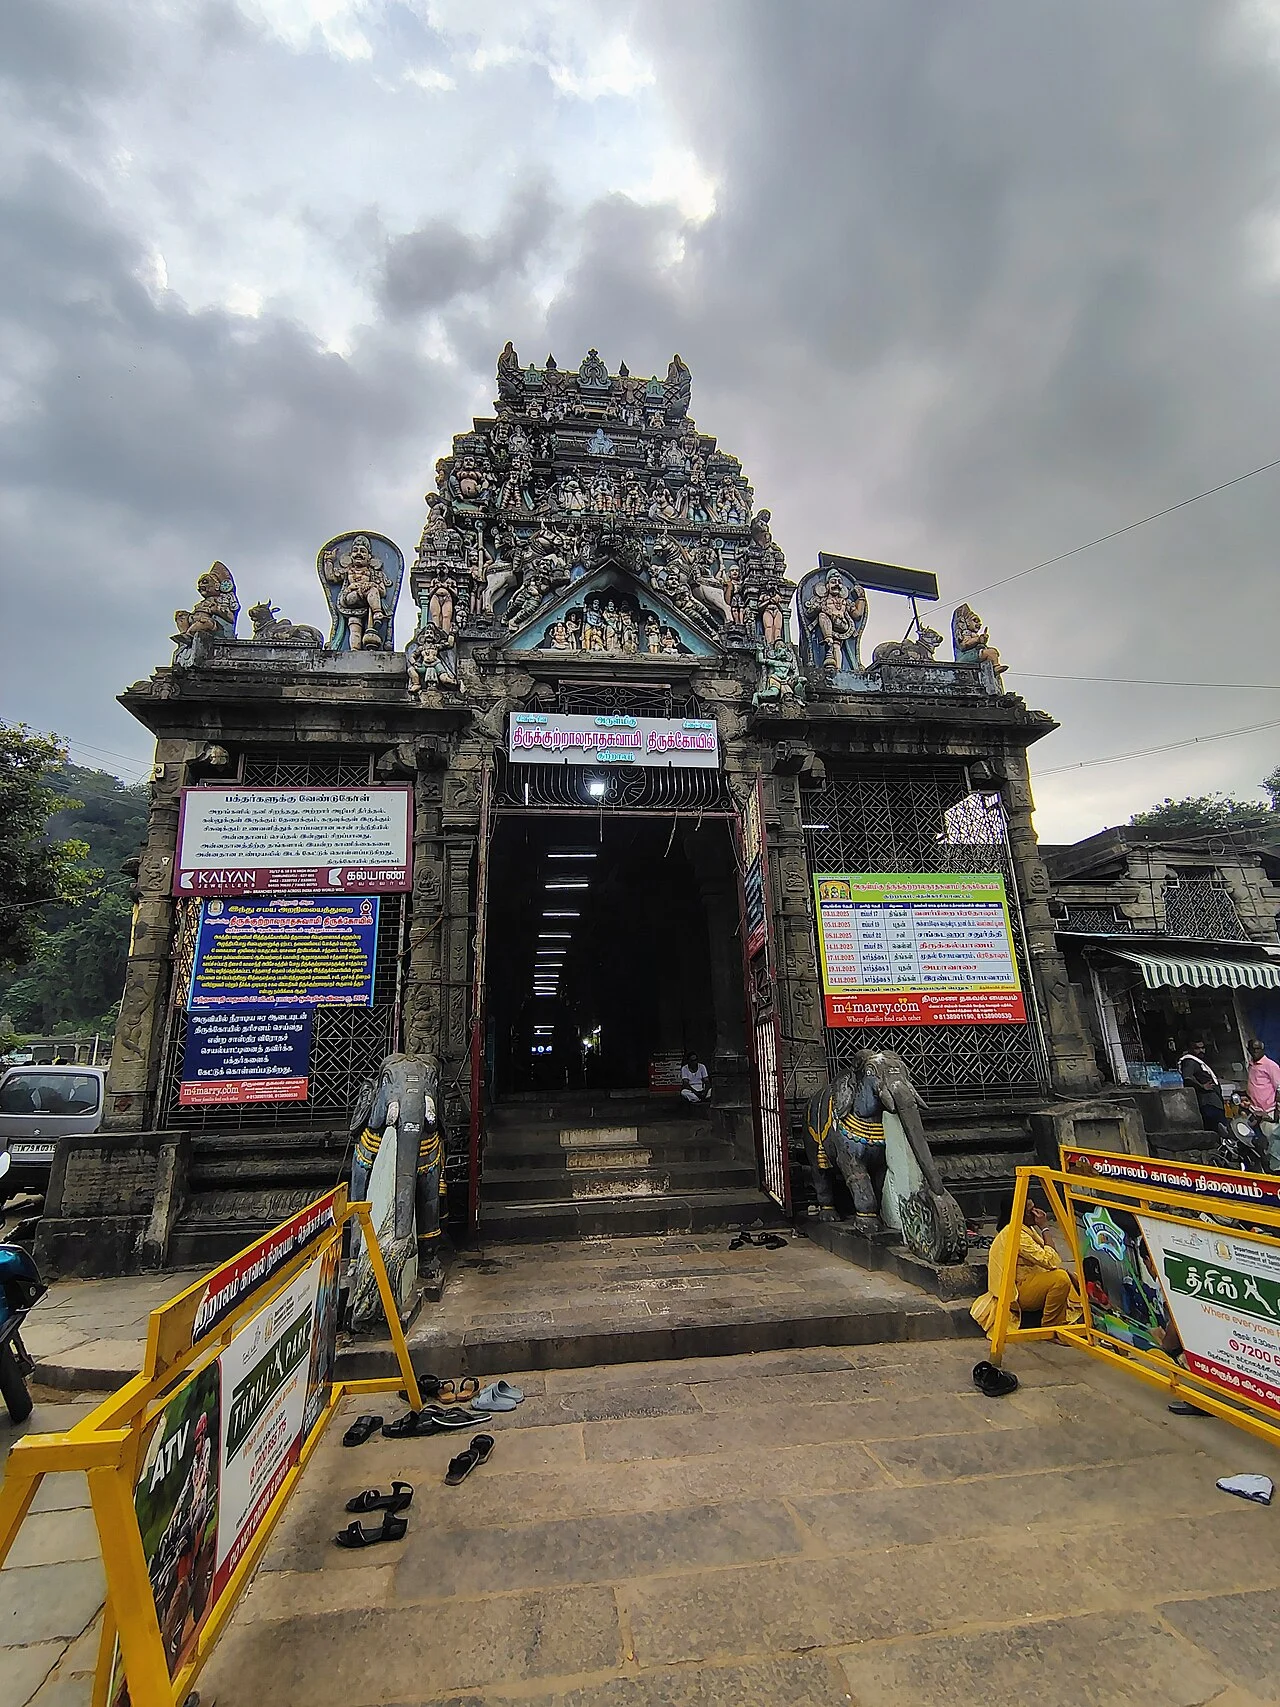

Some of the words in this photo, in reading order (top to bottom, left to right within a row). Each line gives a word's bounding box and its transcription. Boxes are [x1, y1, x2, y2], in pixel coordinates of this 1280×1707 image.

[594, 714, 637, 727] அருள்மிகு
[513, 726, 643, 751] திருக்குற்றாலநாதசுவாமி
[646, 729, 717, 753] திருக்கோயில்
[596, 750, 635, 762] குற்றாலம்
[225, 794, 296, 804] பக்தர்களுக்கு
[299, 793, 371, 803] வேண்டுகோள்
[198, 870, 256, 883] KALYAN
[346, 867, 406, 881] கல்யாண்
[228, 905, 255, 914] இந்து
[229, 915, 323, 927] திருக்குற்றாலநாதசுவாமி
[921, 994, 958, 1003] திருமண
[959, 995, 988, 1003] தகவல்
[832, 1001, 920, 1016] m4marry.com
[191, 1014, 229, 1023] அருவியில்
[228, 1013, 256, 1023] நீராடிய
[267, 1012, 308, 1022] ஆடையுடன்
[846, 1015, 864, 1023] Where
[863, 1015, 884, 1025] families
[194, 1024, 242, 1035] திருக்கோயில்
[241, 1023, 272, 1033] தரிசனம்
[272, 1023, 303, 1033] செய்வது
[207, 1035, 227, 1045] என்ற
[227, 1034, 257, 1044] சாஸ்திர
[257, 1032, 289, 1042] விரோதச்
[200, 1045, 264, 1055] செயல்பாட்டினைத்
[263, 1043, 294, 1054] தவிர்க்க
[222, 1054, 270, 1065] பக்தர்களைக்
[197, 1066, 225, 1077] கேட்டுக்
[225, 1065, 293, 1076] கொள்ளப்படுகிறது.
[183, 1085, 239, 1096] m4marry.com
[1150, 1170, 1193, 1188] காவல்
[1194, 1176, 1264, 1199] நிலையம்
[1232, 1244, 1259, 1256] Department
[239, 1248, 266, 1292] காவல்
[265, 1227, 296, 1276] நிலையம்
[1234, 1251, 1261, 1263] Government
[1200, 1304, 1231, 1322] Where
[1232, 1317, 1275, 1336] everyone
[1239, 1342, 1272, 1364] 7200
[148, 1418, 193, 1497] ATV
